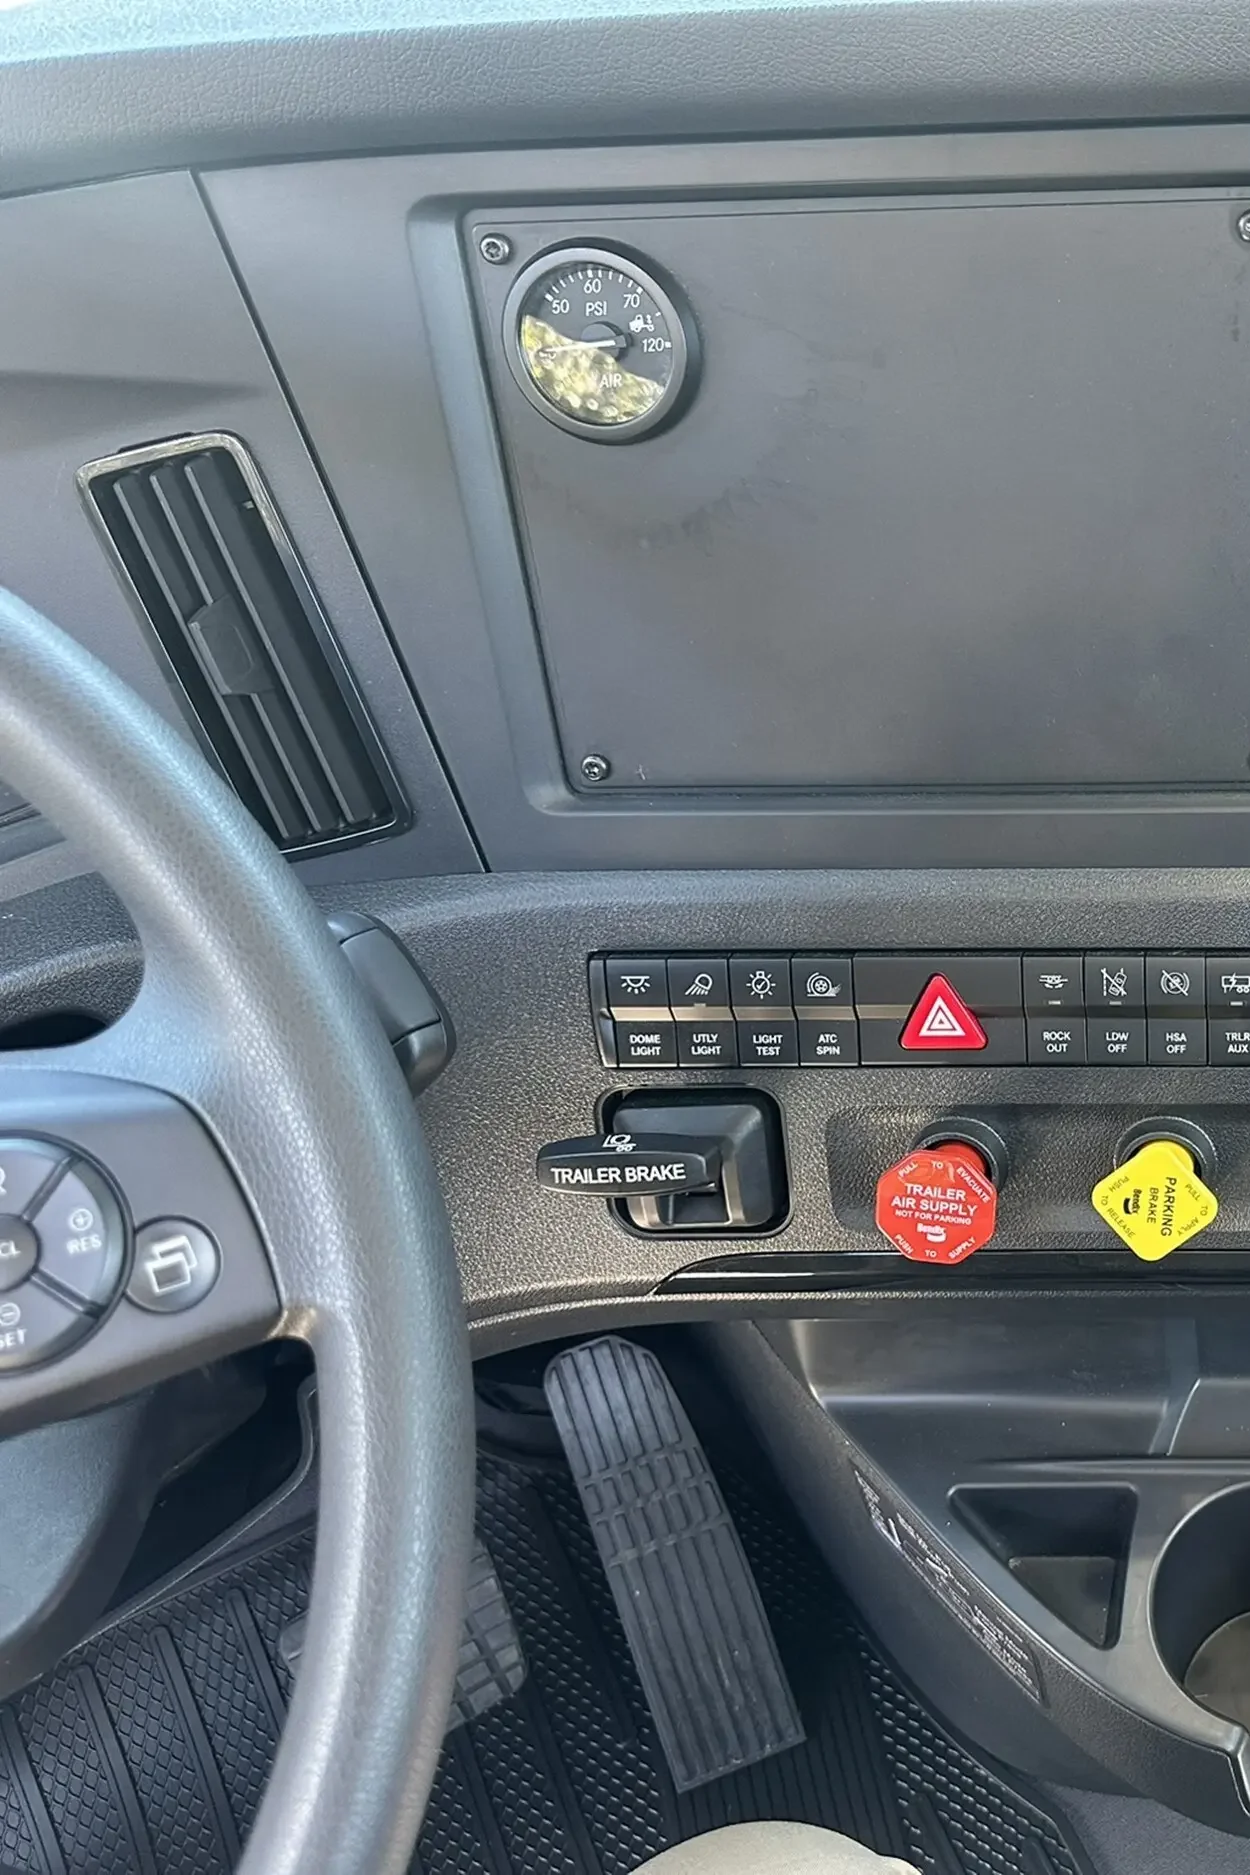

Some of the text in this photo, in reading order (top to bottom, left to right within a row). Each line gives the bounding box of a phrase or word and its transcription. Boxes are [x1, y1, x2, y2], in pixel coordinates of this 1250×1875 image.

[583, 278, 601, 294] 60
[552, 299, 569, 314] 50
[623, 294, 640, 308] 70
[586, 302, 607, 316] PSI
[642, 338, 664, 352] 120
[599, 373, 622, 388] AIR
[629, 1034, 661, 1045] DOME
[693, 1033, 718, 1044] UTLY
[753, 1034, 783, 1045] LIGHT
[818, 1034, 838, 1044] ATC
[1043, 1031, 1071, 1042] ROCK
[1106, 1032, 1129, 1042] LDW
[1166, 1033, 1187, 1043] HSA
[1225, 1032, 1250, 1042] TRLR
[631, 1046, 661, 1056] LIGHT
[691, 1045, 721, 1056] LIGHT
[756, 1046, 781, 1056] TEST
[816, 1045, 840, 1056] SPIN
[1046, 1043, 1068, 1054] OUT
[1107, 1043, 1127, 1054] OFF
[1166, 1044, 1186, 1054] OFF
[1227, 1043, 1249, 1054] AUX
[550, 1163, 687, 1184] TRAILER BRAKE
[898, 1160, 991, 1203] PULL TO EVACUATE
[905, 1183, 967, 1201] TRAILER
[891, 1196, 978, 1217] AIR SUPPLY
[1146, 1187, 1159, 1224] BRAKE
[1160, 1176, 1177, 1237] PARKING
[1185, 1183, 1201, 1201] PULL
[1200, 1205, 1209, 1217] TO
[895, 1209, 972, 1226] NOT FOR PARKING
[1101, 1195, 1109, 1206] TO
[1107, 1207, 1136, 1238] RELEASE
[66, 1234, 102, 1255] RES
[895, 1234, 976, 1259] PUSH TO SUPPLY
